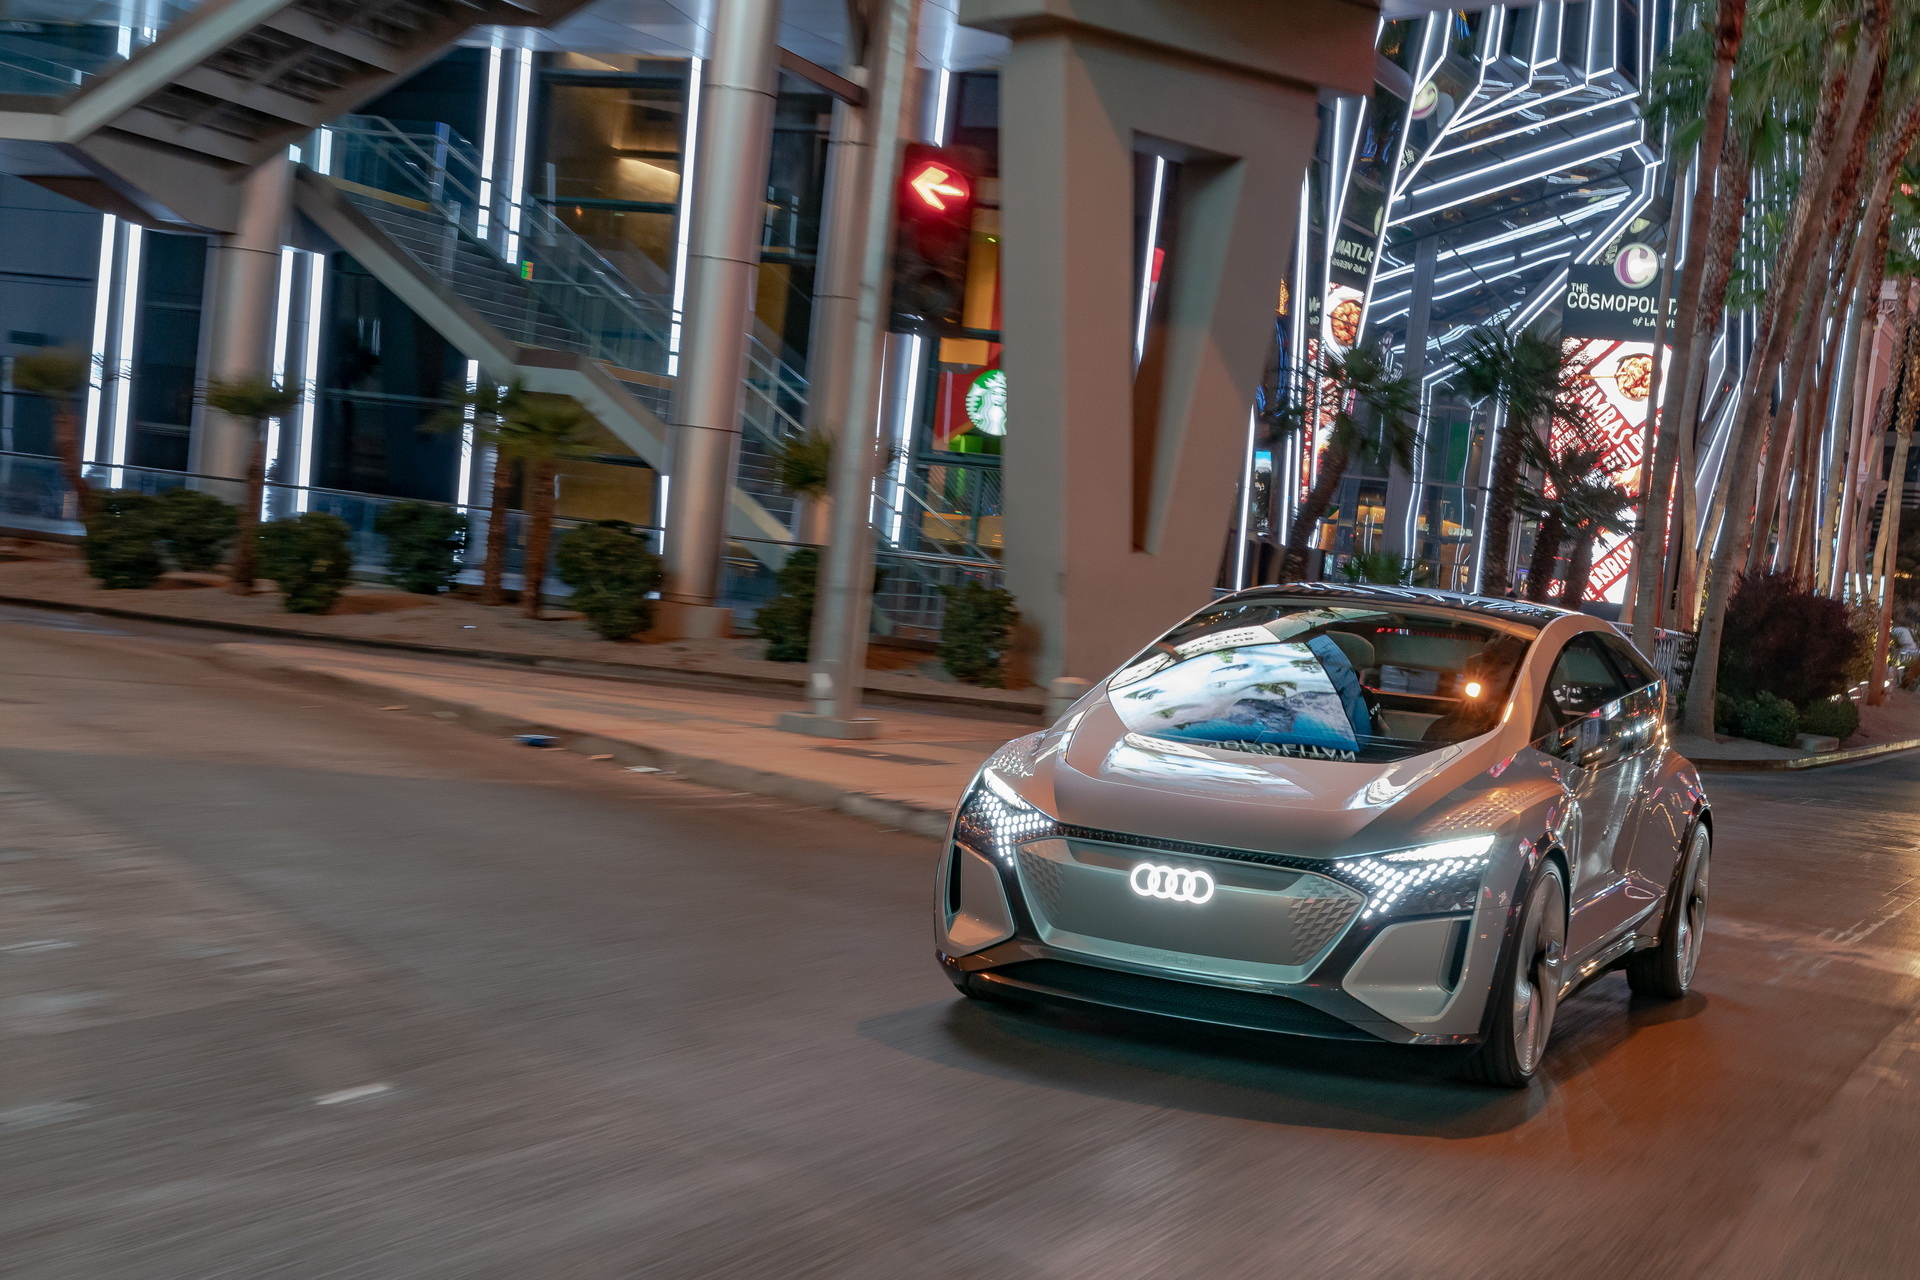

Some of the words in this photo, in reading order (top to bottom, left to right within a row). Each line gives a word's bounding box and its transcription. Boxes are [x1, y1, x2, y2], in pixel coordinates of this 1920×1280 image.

[1571, 282, 1588, 293] THE
[1567, 292, 1678, 315] COSMOPOLT
[1632, 317, 1643, 327] of
[1644, 317, 1656, 327] LA
